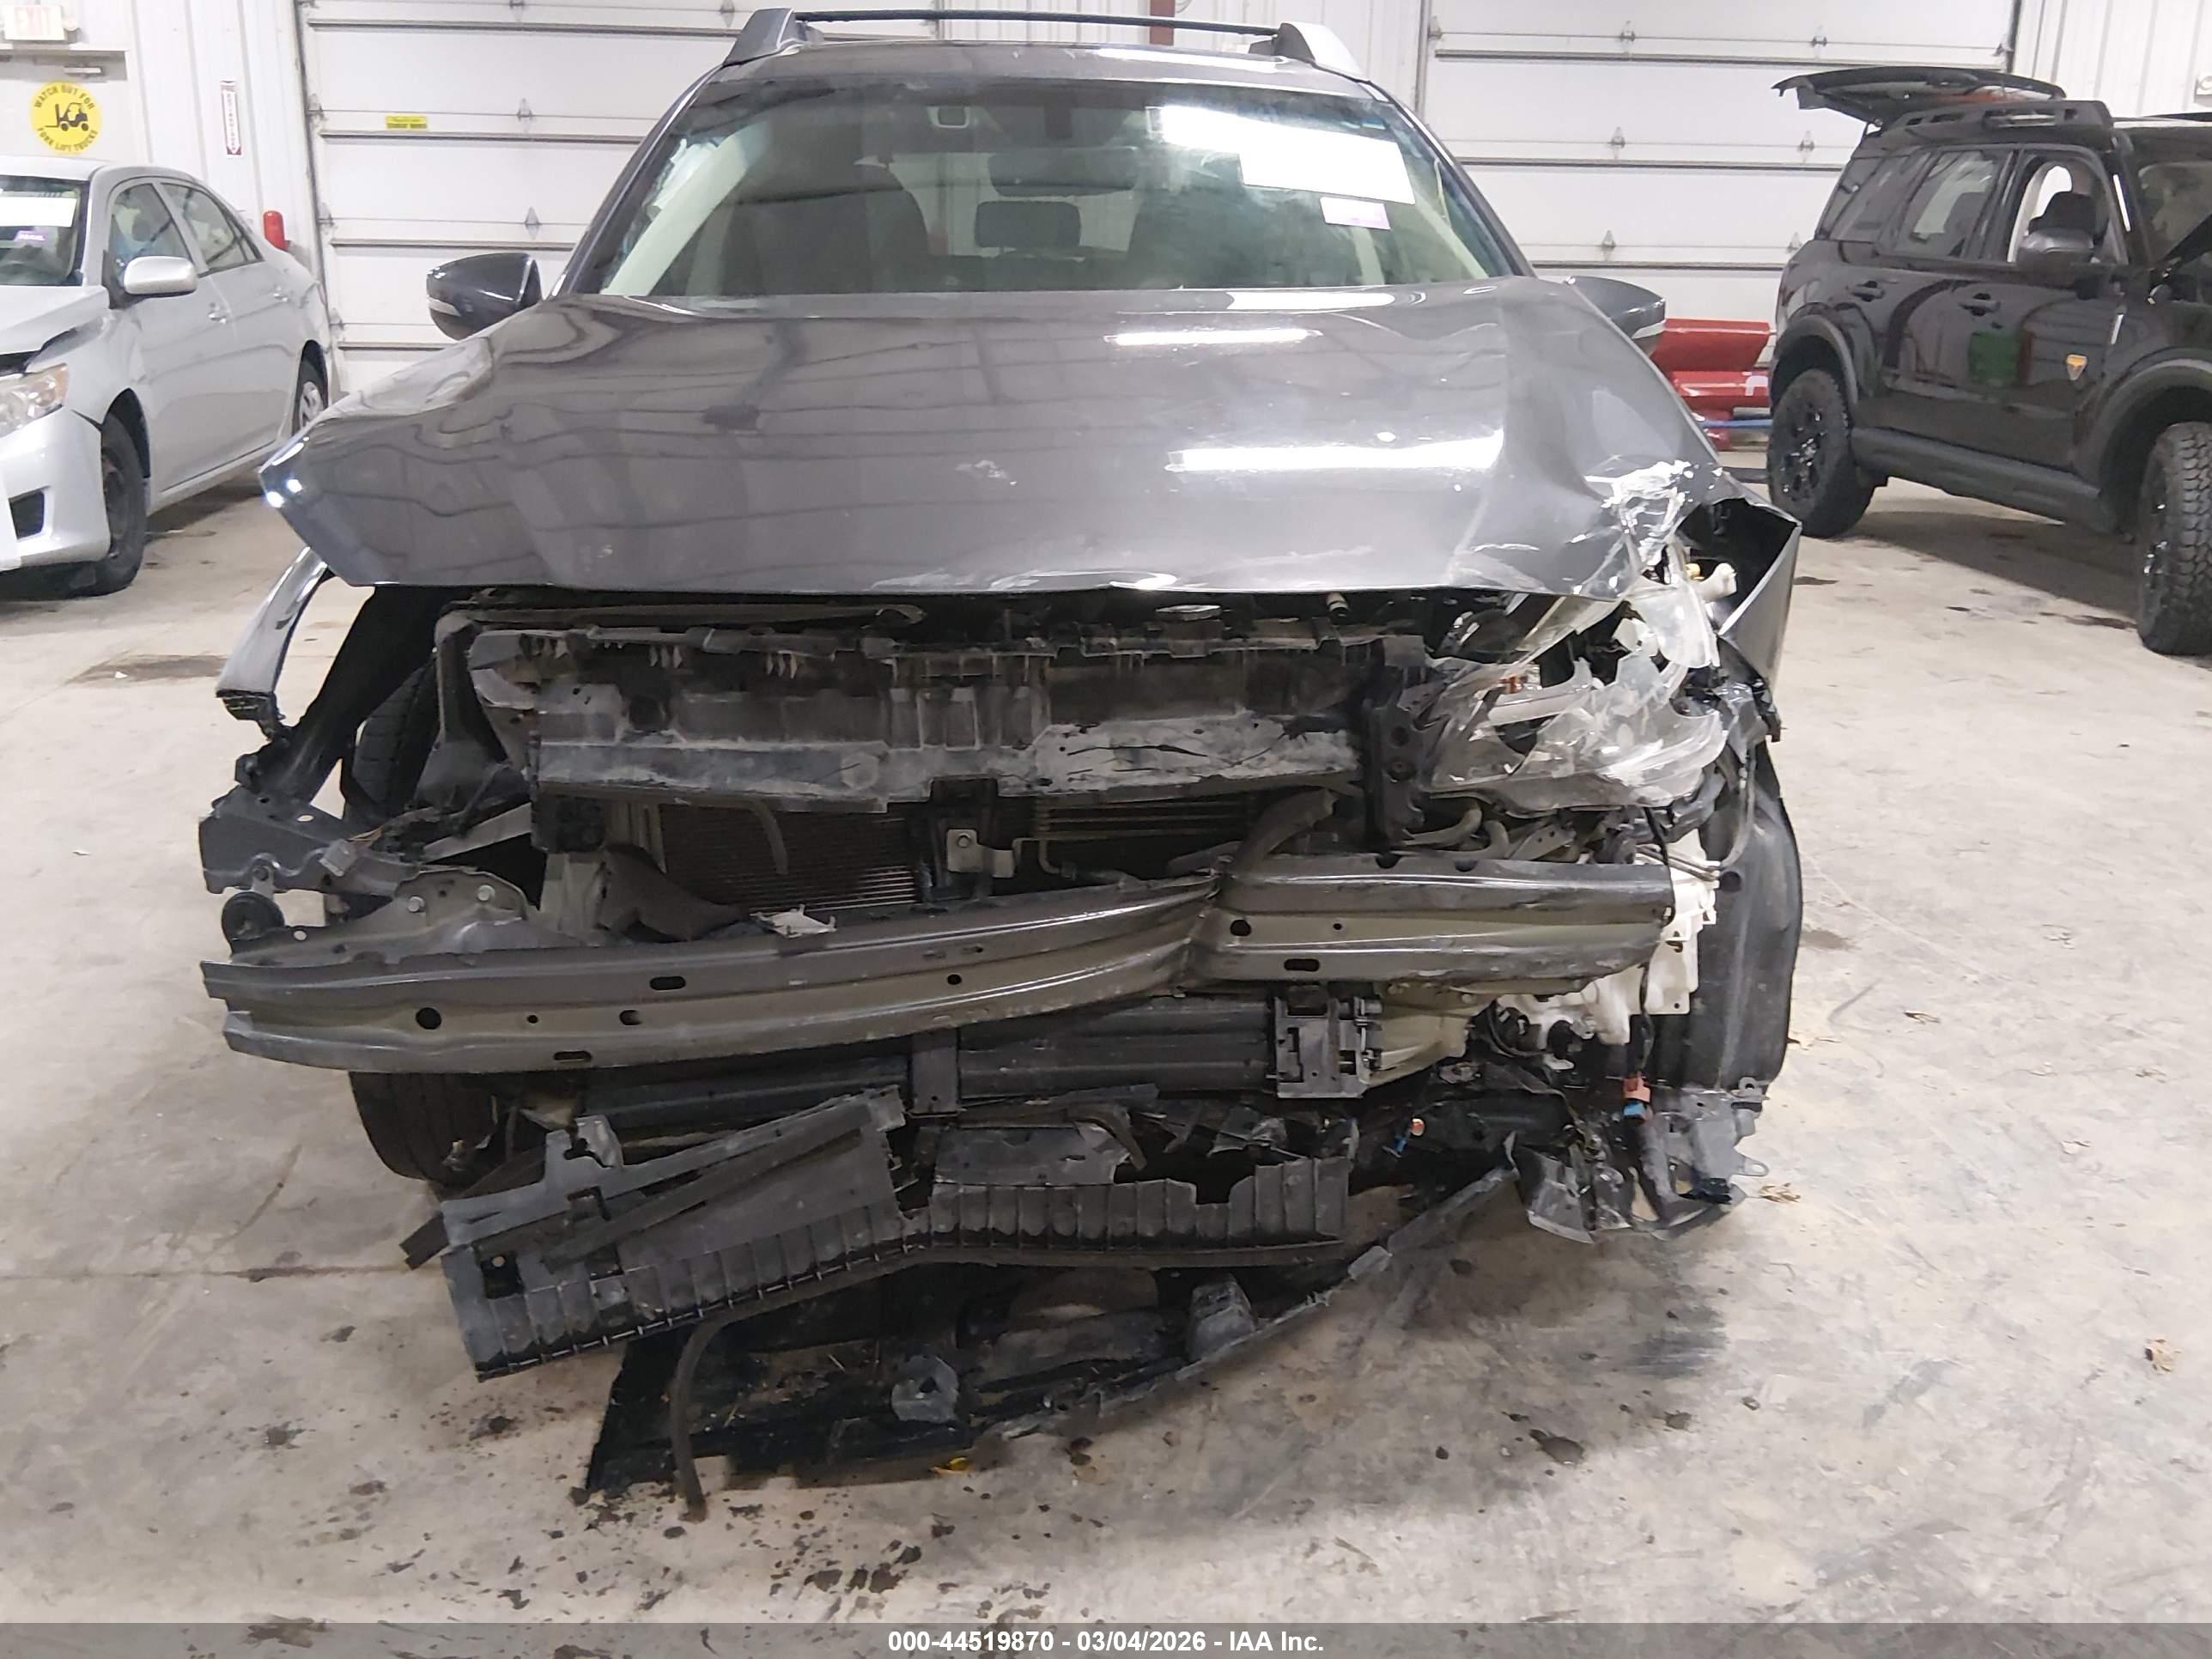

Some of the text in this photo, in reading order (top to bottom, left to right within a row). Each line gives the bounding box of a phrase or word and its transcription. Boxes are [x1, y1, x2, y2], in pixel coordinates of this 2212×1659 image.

[13, 6, 52, 36] EXIT
[34, 85, 95, 109] WATCH OUT FOR
[37, 127, 99, 153] FORK LIFT TRUCKS
